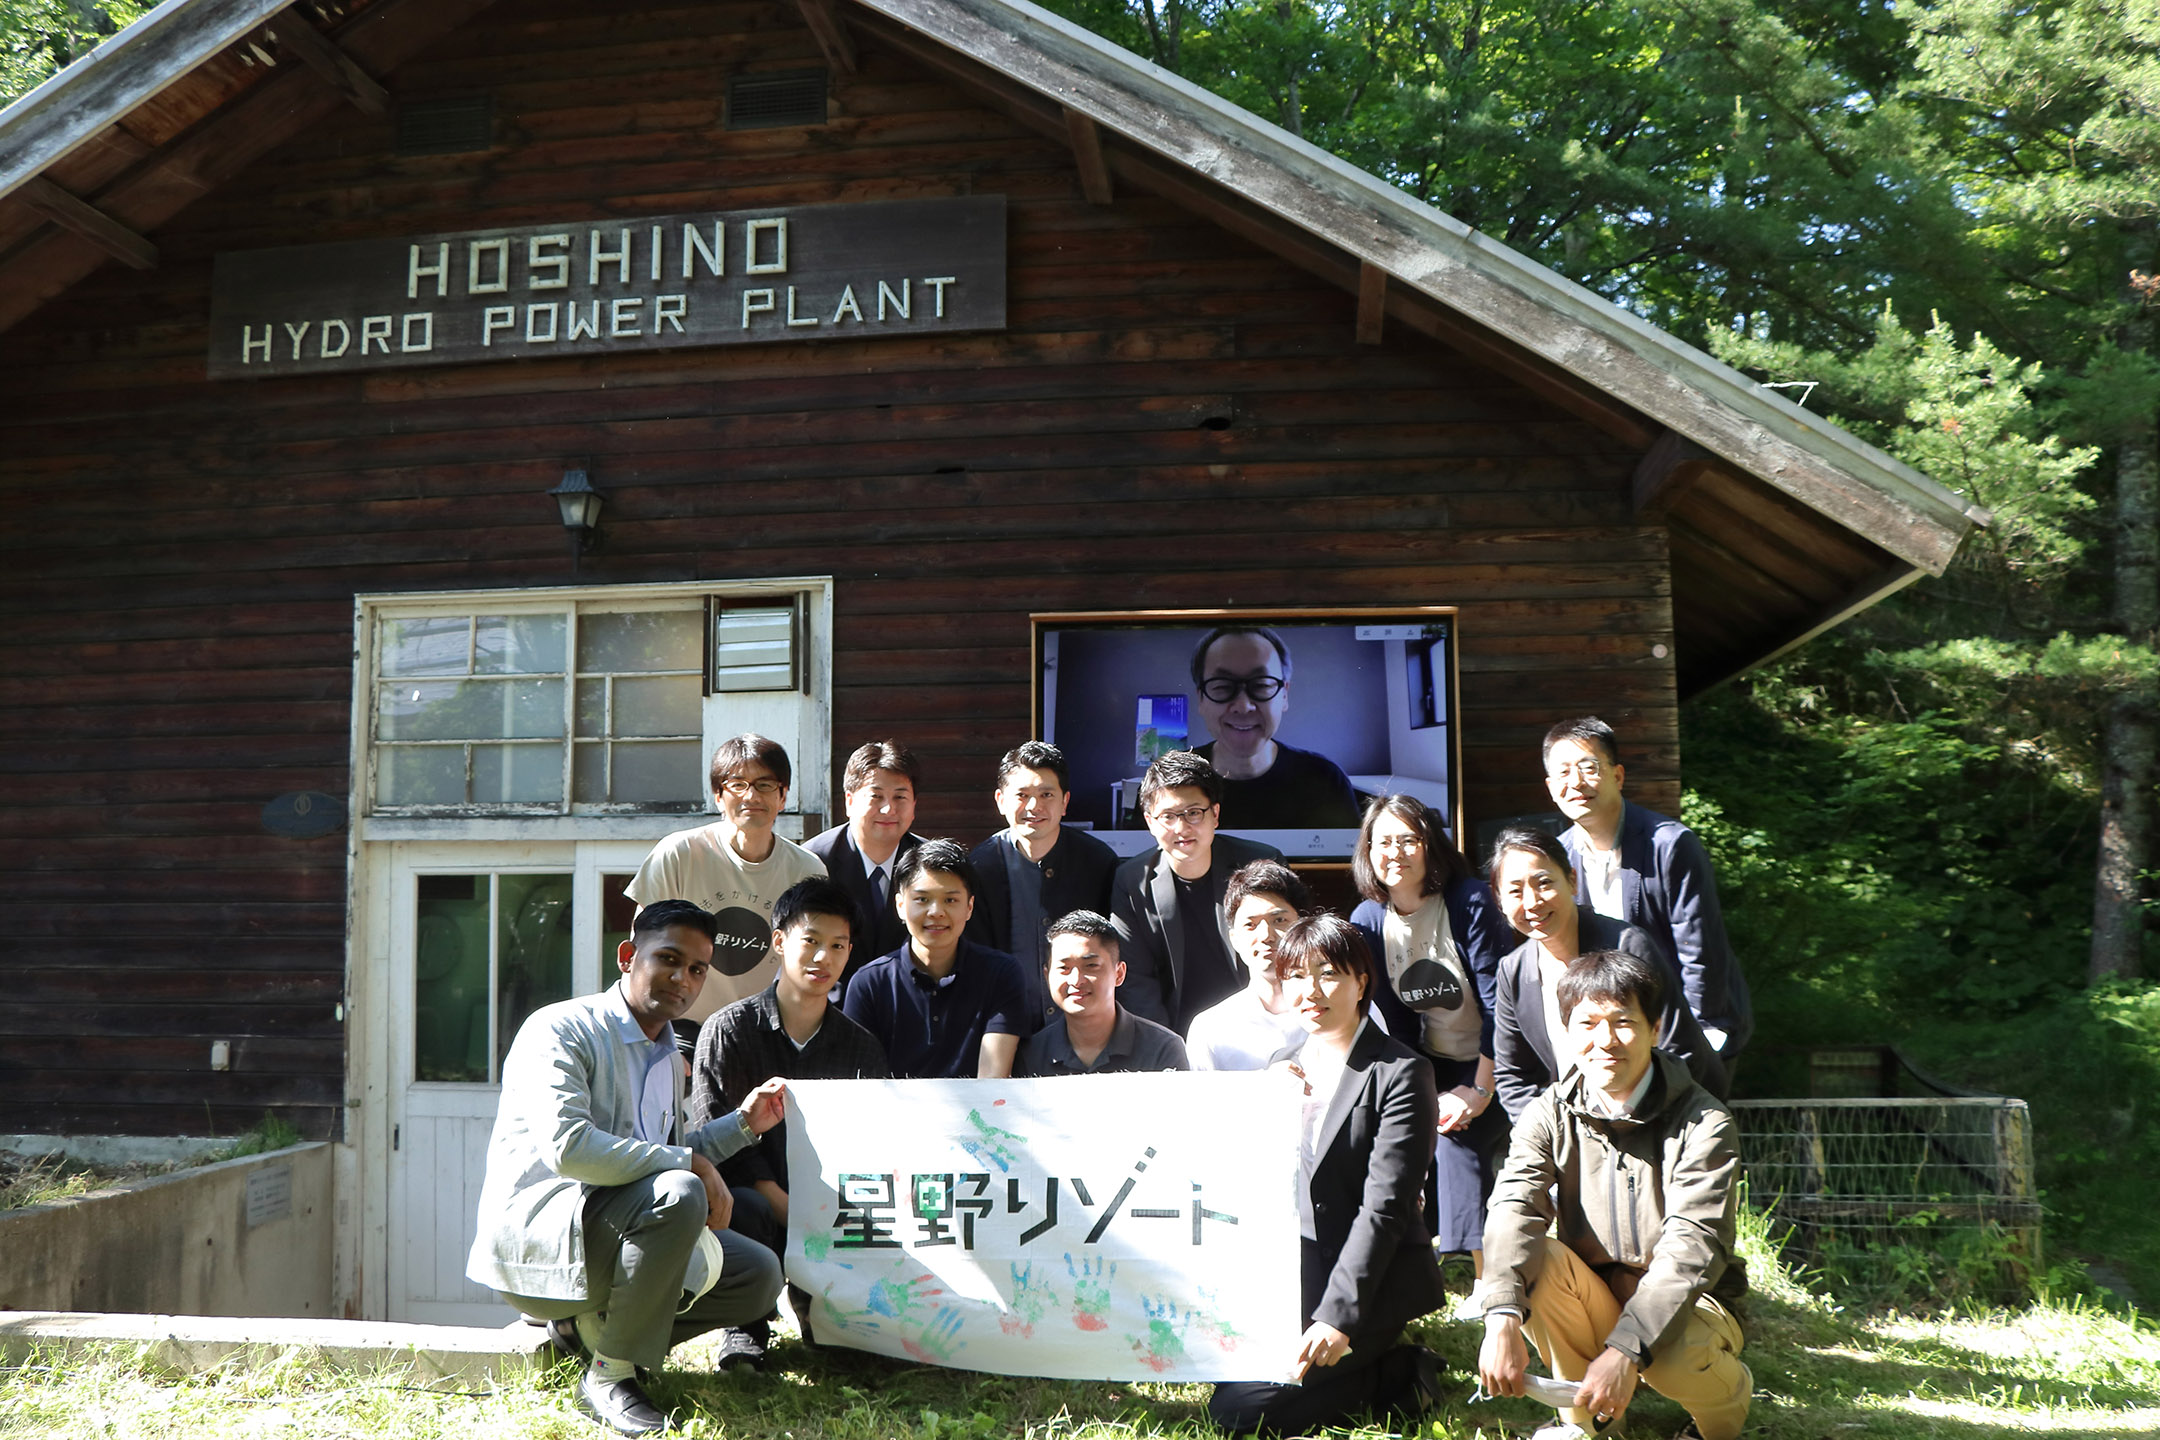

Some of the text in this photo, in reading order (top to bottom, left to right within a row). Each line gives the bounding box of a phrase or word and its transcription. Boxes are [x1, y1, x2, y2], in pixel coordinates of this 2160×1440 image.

[408, 216, 788, 299] HOSHINO
[242, 275, 956, 364] HYDRO POWER PLANT
[714, 932, 769, 952] 野リゾート
[832, 1145, 1239, 1251] 星野リゾート
